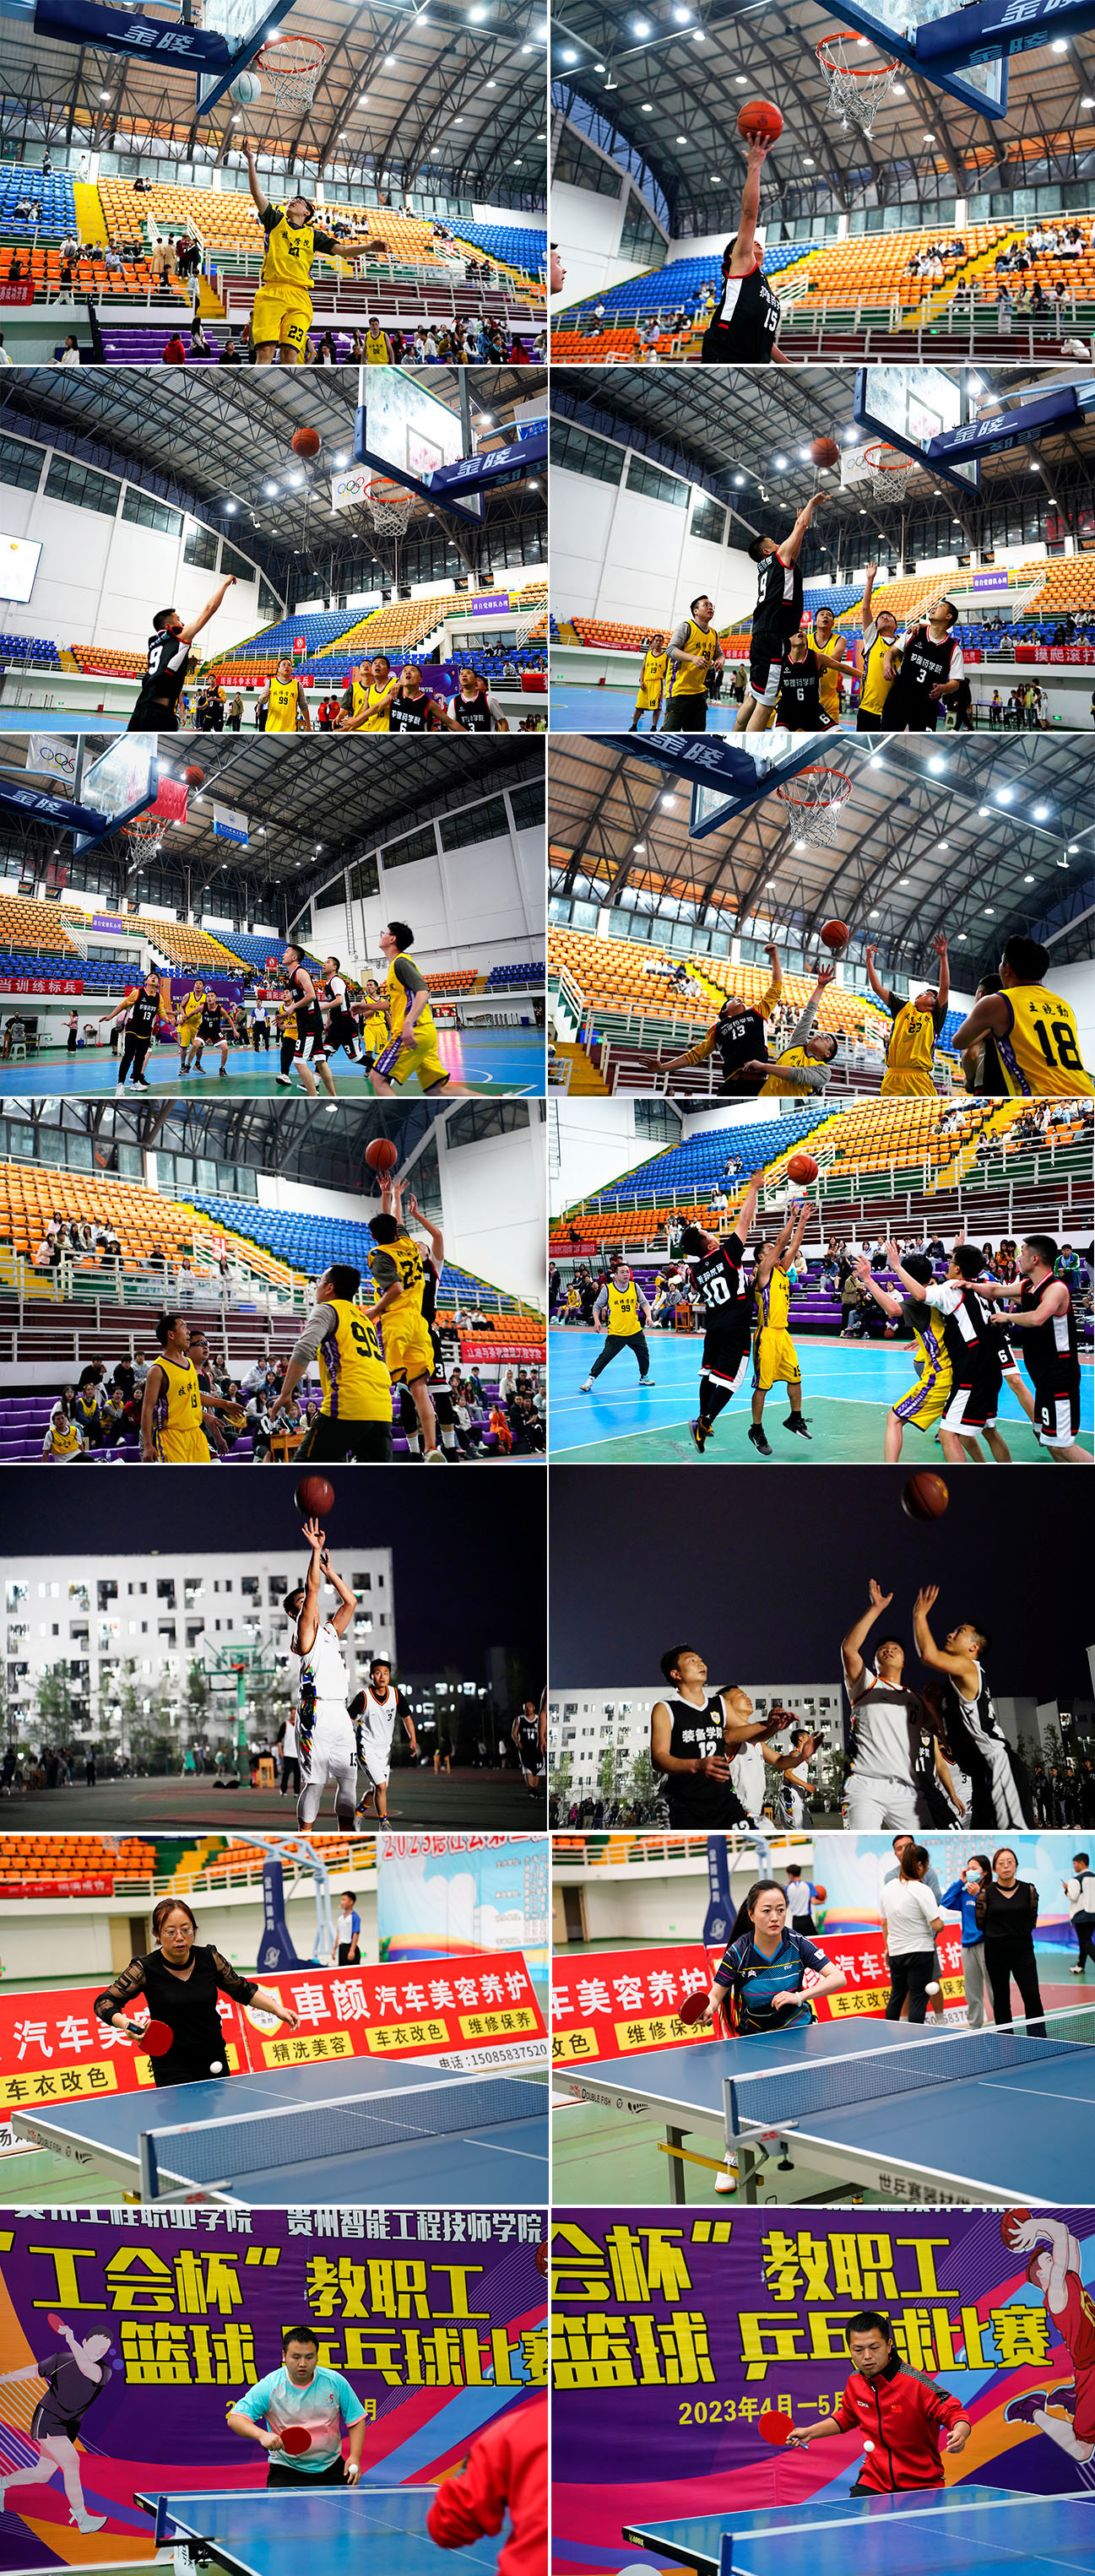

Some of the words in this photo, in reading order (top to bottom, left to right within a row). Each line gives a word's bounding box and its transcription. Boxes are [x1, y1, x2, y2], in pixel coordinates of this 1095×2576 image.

[110, 25, 203, 57] 金陵
[763, 307, 778, 332] 15
[292, 325, 304, 342] 23
[945, 415, 1016, 447] 金陵
[449, 447, 524, 481] 金陵
[149, 645, 164, 676] 9
[1035, 647, 1095, 663] 摸爬滚打
[916, 668, 927, 683] 3
[279, 696, 289, 706] 99
[797, 688, 805, 701] 6
[819, 713, 832, 725] 6
[637, 734, 731, 777] 金陵
[3, 790, 68, 818] 金陵
[144, 1011, 152, 1020] 13
[732, 1024, 746, 1041] 13
[908, 1022, 923, 1034] 23
[295, 1040, 301, 1051] 9
[344, 1045, 351, 1054] 3
[1033, 1019, 1084, 1071] 18
[621, 1305, 632, 1313] 99
[350, 1321, 386, 1363] 99
[997, 1349, 1009, 1364] 6
[435, 1363, 444, 1378] 3
[1041, 1406, 1050, 1426] 9
[698, 1740, 718, 1759] 12
[961, 1774, 968, 1784] 3
[375, 1970, 529, 2017] 汽车美容养护
[272, 2036, 346, 2064] 精洗美容
[374, 2022, 444, 2048] 车衣改色
[467, 2011, 531, 2036] 维修保养
[5, 2067, 109, 2102] 车衣改色
[287, 2210, 543, 2243] 贵州智能工程技师学院
[761, 2230, 960, 2302] 教职工
[306, 2255, 491, 2319] 教职工
[121, 2320, 257, 2386] 篮球
[551, 2311, 717, 2389] 篮球
